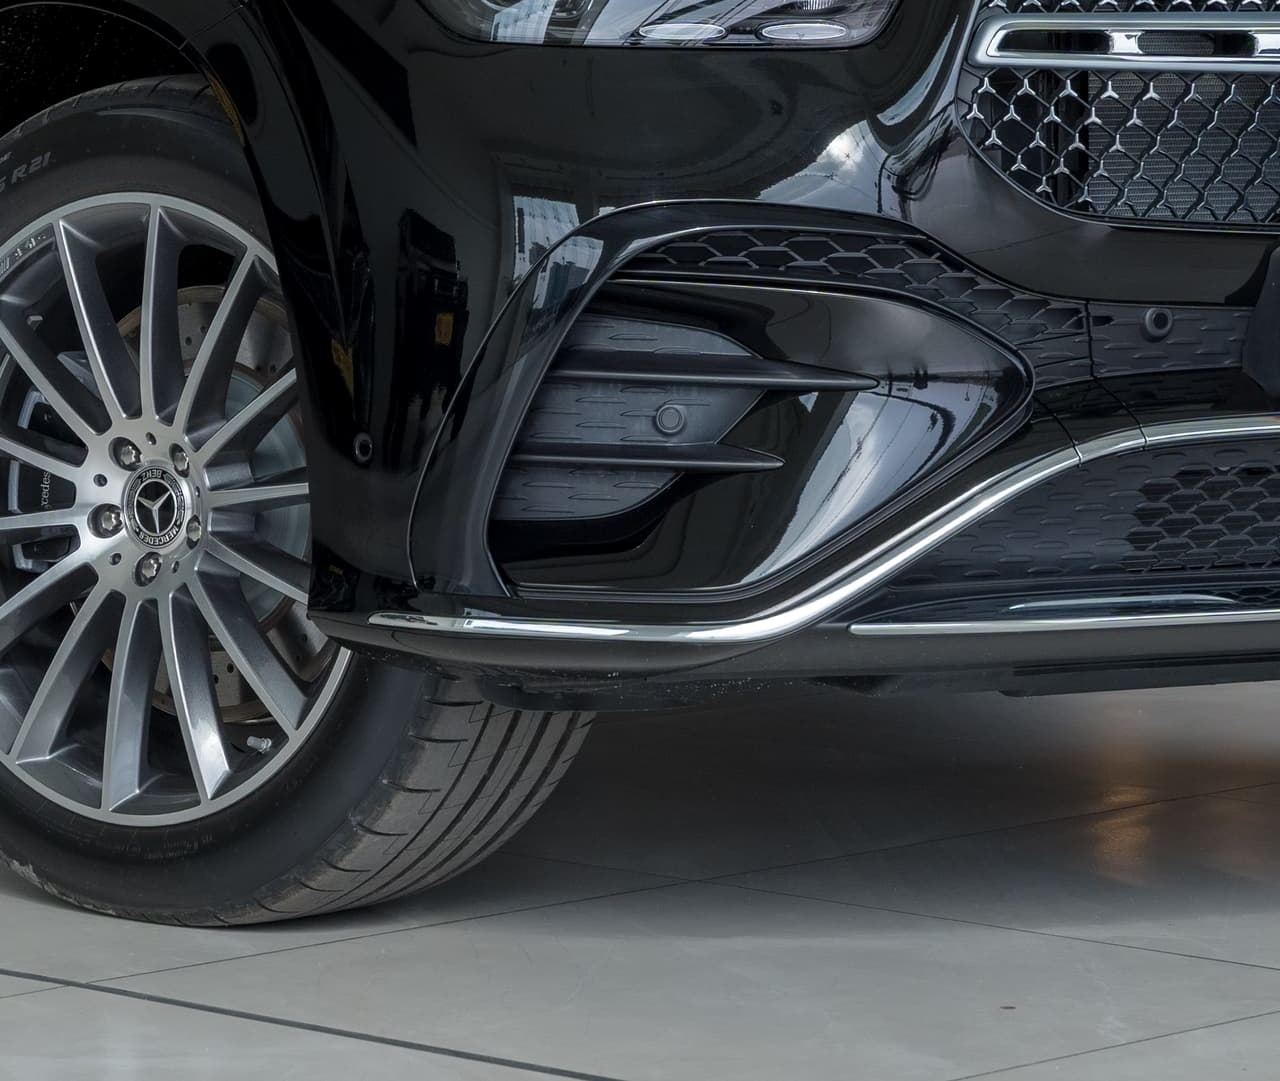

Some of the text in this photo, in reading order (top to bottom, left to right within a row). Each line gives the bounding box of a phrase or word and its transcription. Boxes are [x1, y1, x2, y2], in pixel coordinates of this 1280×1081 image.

[141, 469, 163, 482] BENZ
[40, 471, 51, 506] cedes
[138, 524, 179, 546] MERCEDES
